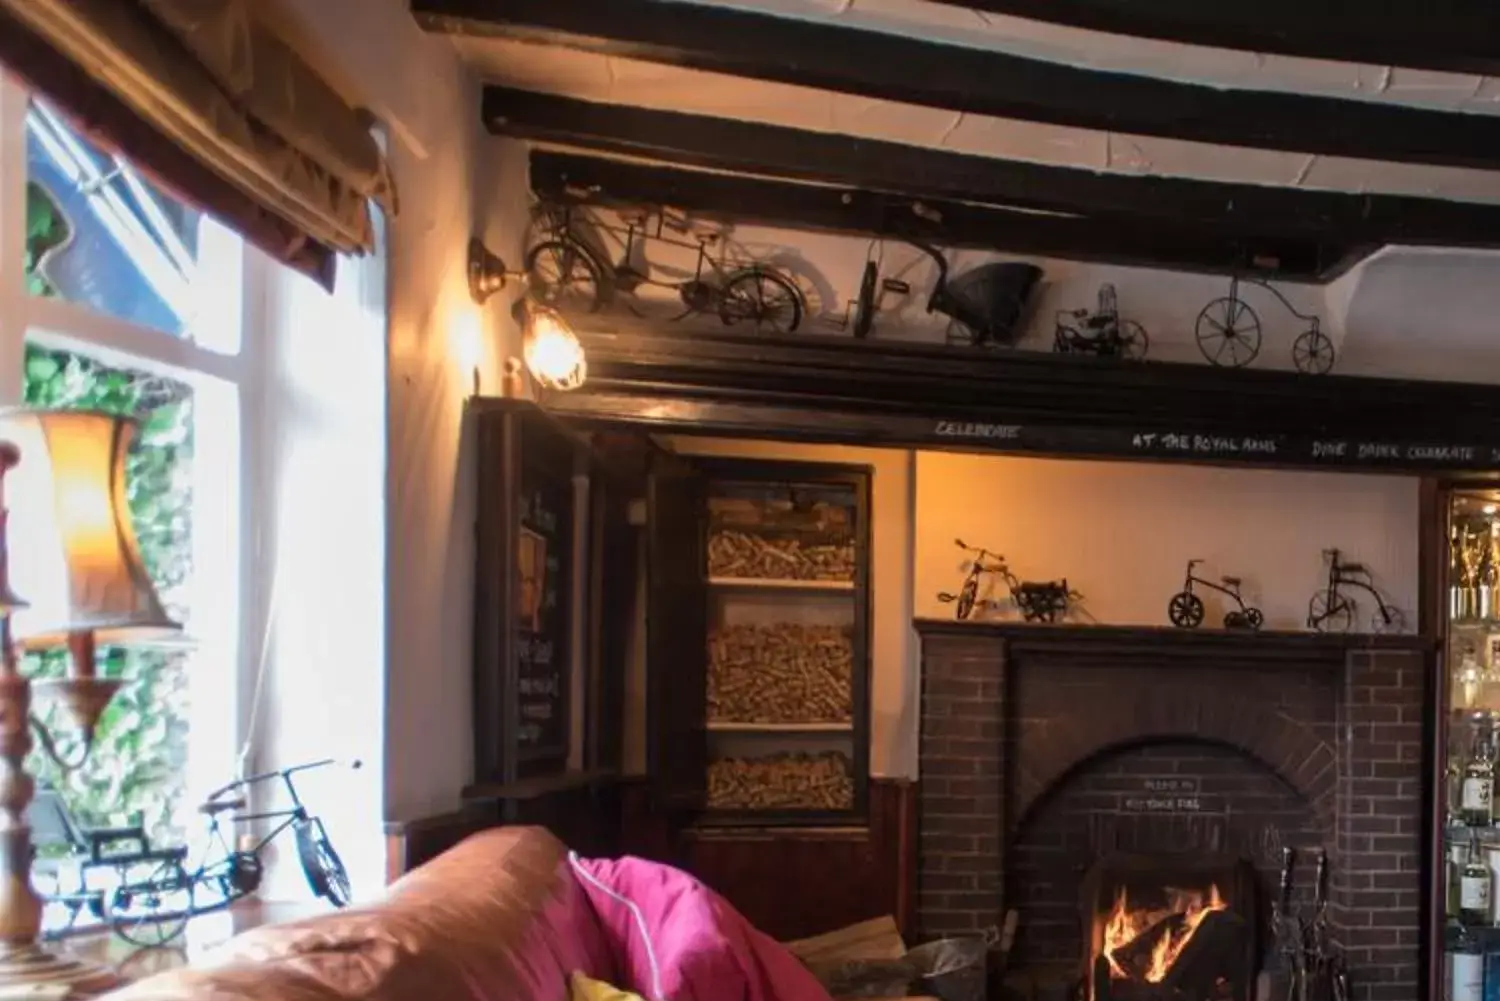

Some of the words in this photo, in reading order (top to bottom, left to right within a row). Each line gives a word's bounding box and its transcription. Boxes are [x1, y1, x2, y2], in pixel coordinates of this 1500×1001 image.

[1132, 432, 1157, 448] AT
[1161, 432, 1190, 449] THE
[1194, 434, 1239, 451] ROYAL
[1358, 443, 1400, 459] DRINK
